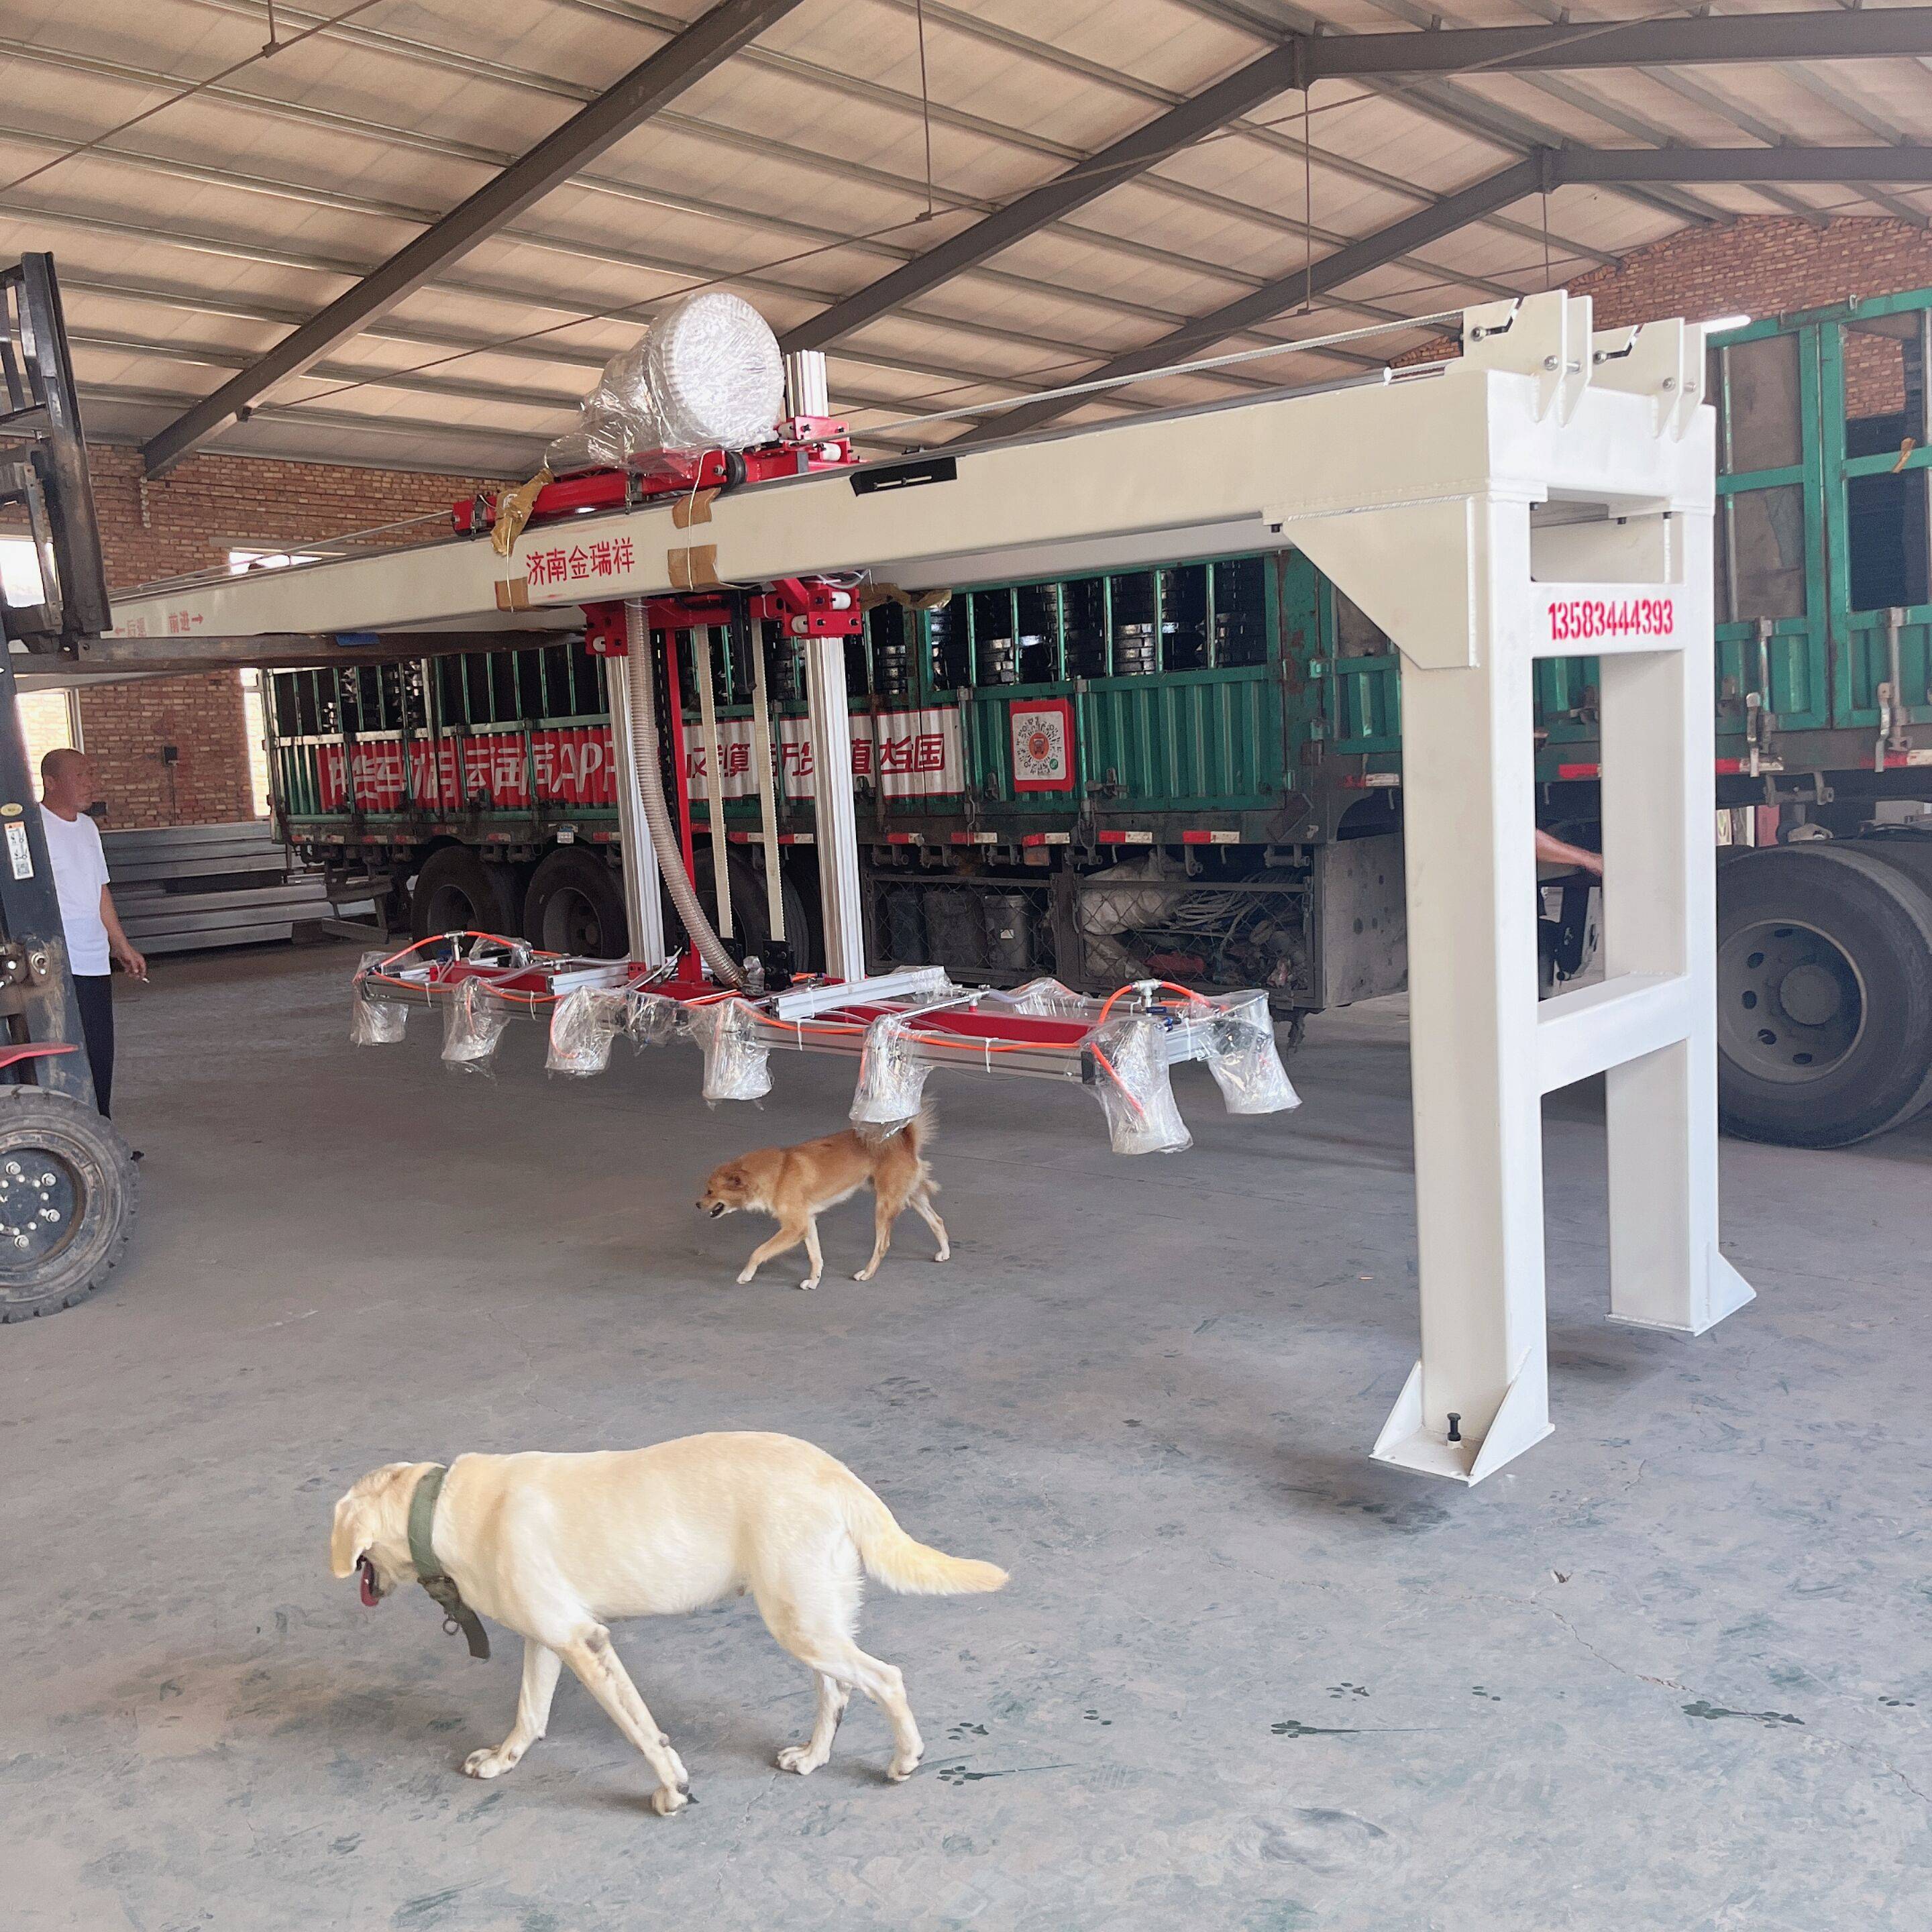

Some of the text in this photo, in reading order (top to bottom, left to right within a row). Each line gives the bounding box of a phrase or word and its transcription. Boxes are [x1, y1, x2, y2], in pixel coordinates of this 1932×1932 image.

[526, 537, 635, 586] 济南金瑞祥
[1548, 599, 1674, 640] 13583444393
